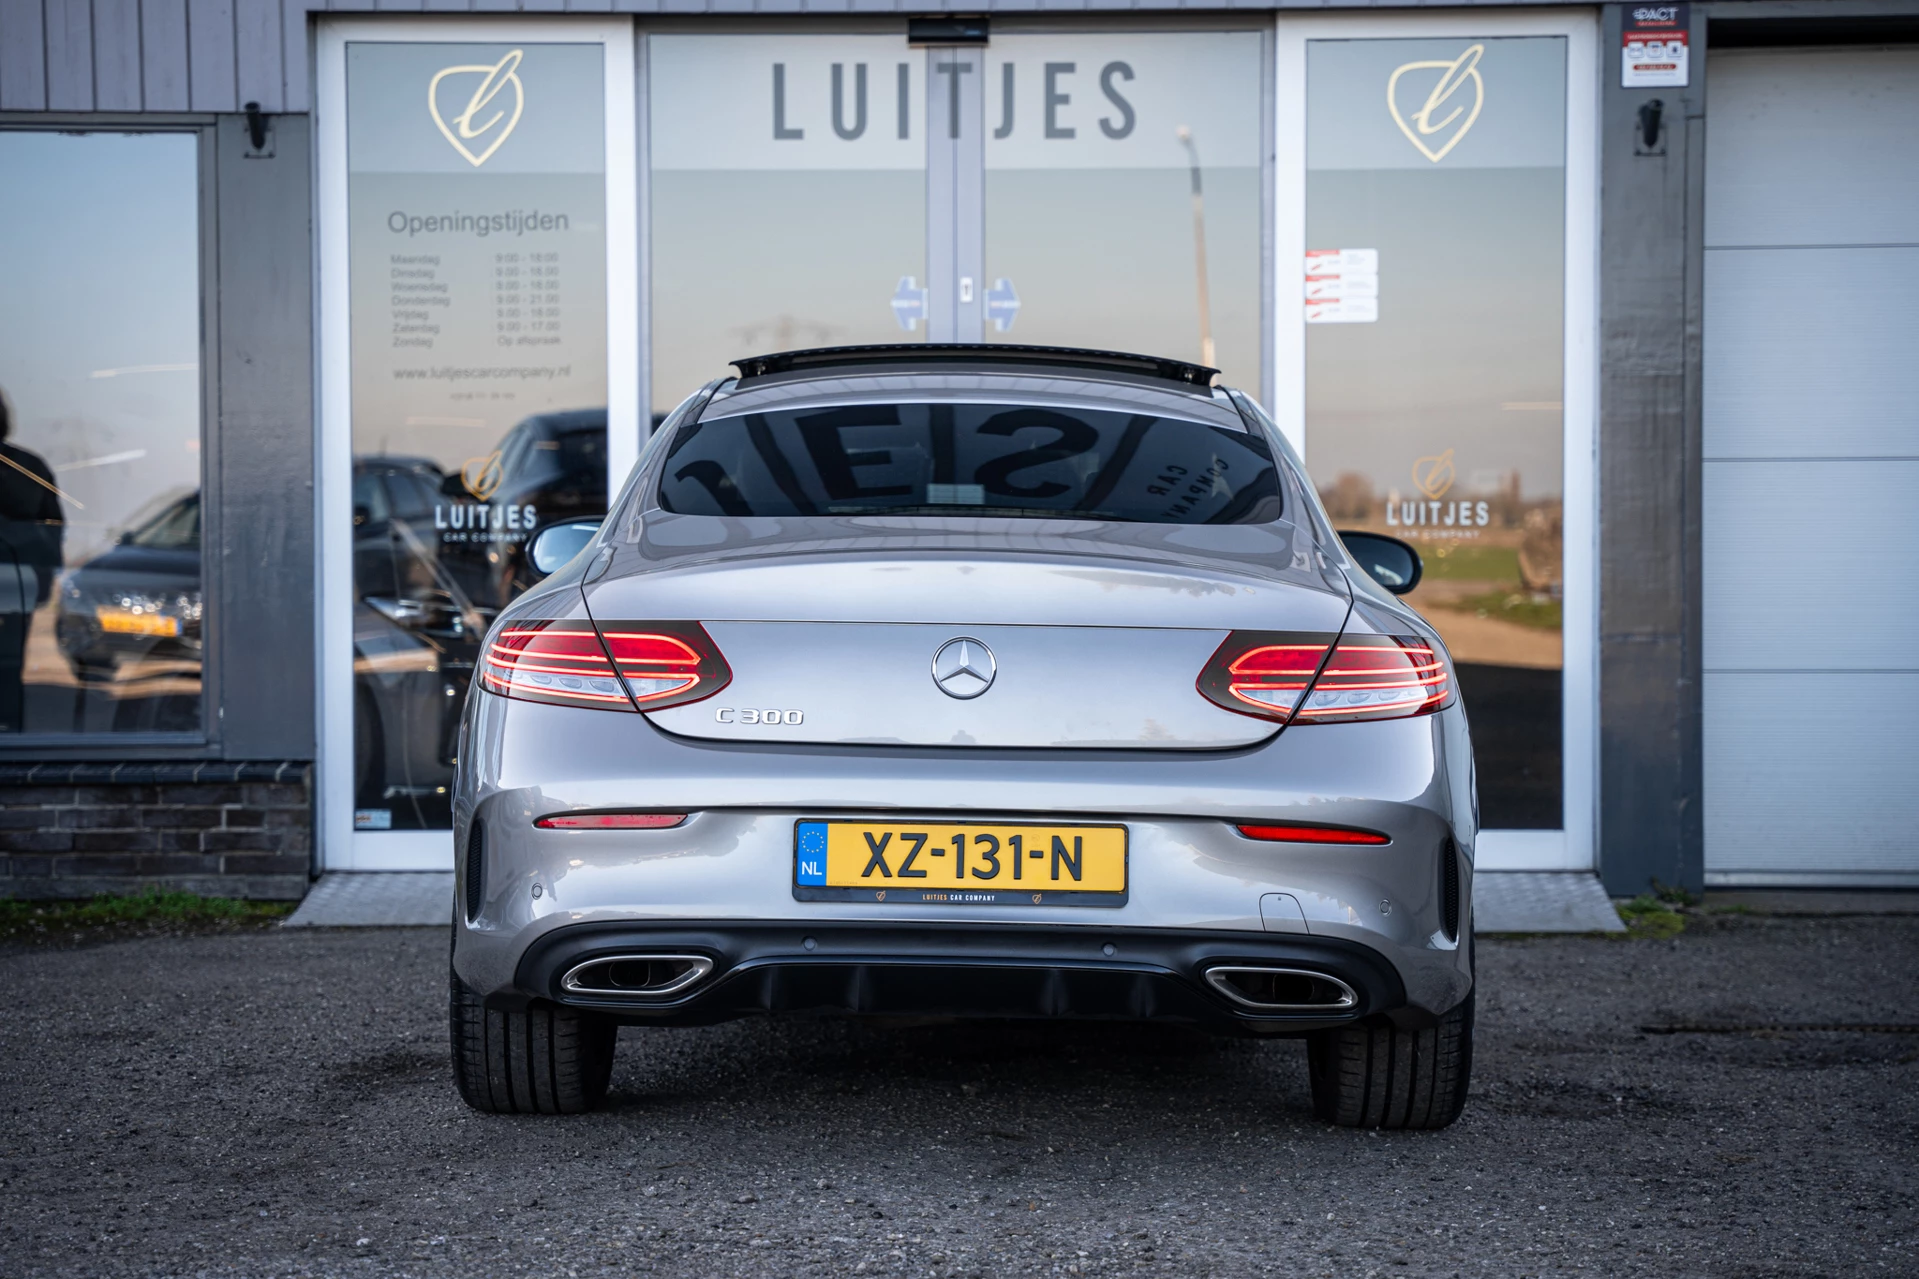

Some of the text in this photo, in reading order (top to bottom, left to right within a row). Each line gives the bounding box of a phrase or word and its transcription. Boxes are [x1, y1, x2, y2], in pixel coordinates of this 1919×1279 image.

[772, 61, 1137, 141] LUITJES
[388, 210, 569, 237] Openingstijden
[393, 336, 434, 349] Zondag
[393, 364, 572, 382] www.luitjescarcompany.nl
[435, 504, 537, 530] LUITJES
[1386, 501, 1489, 527] LUITJES
[715, 707, 804, 725] C 300
[861, 832, 1082, 881] XZ-131-N
[801, 861, 823, 876] NL
[922, 893, 947, 901] LUITJES
[965, 894, 995, 902] COMPANY
